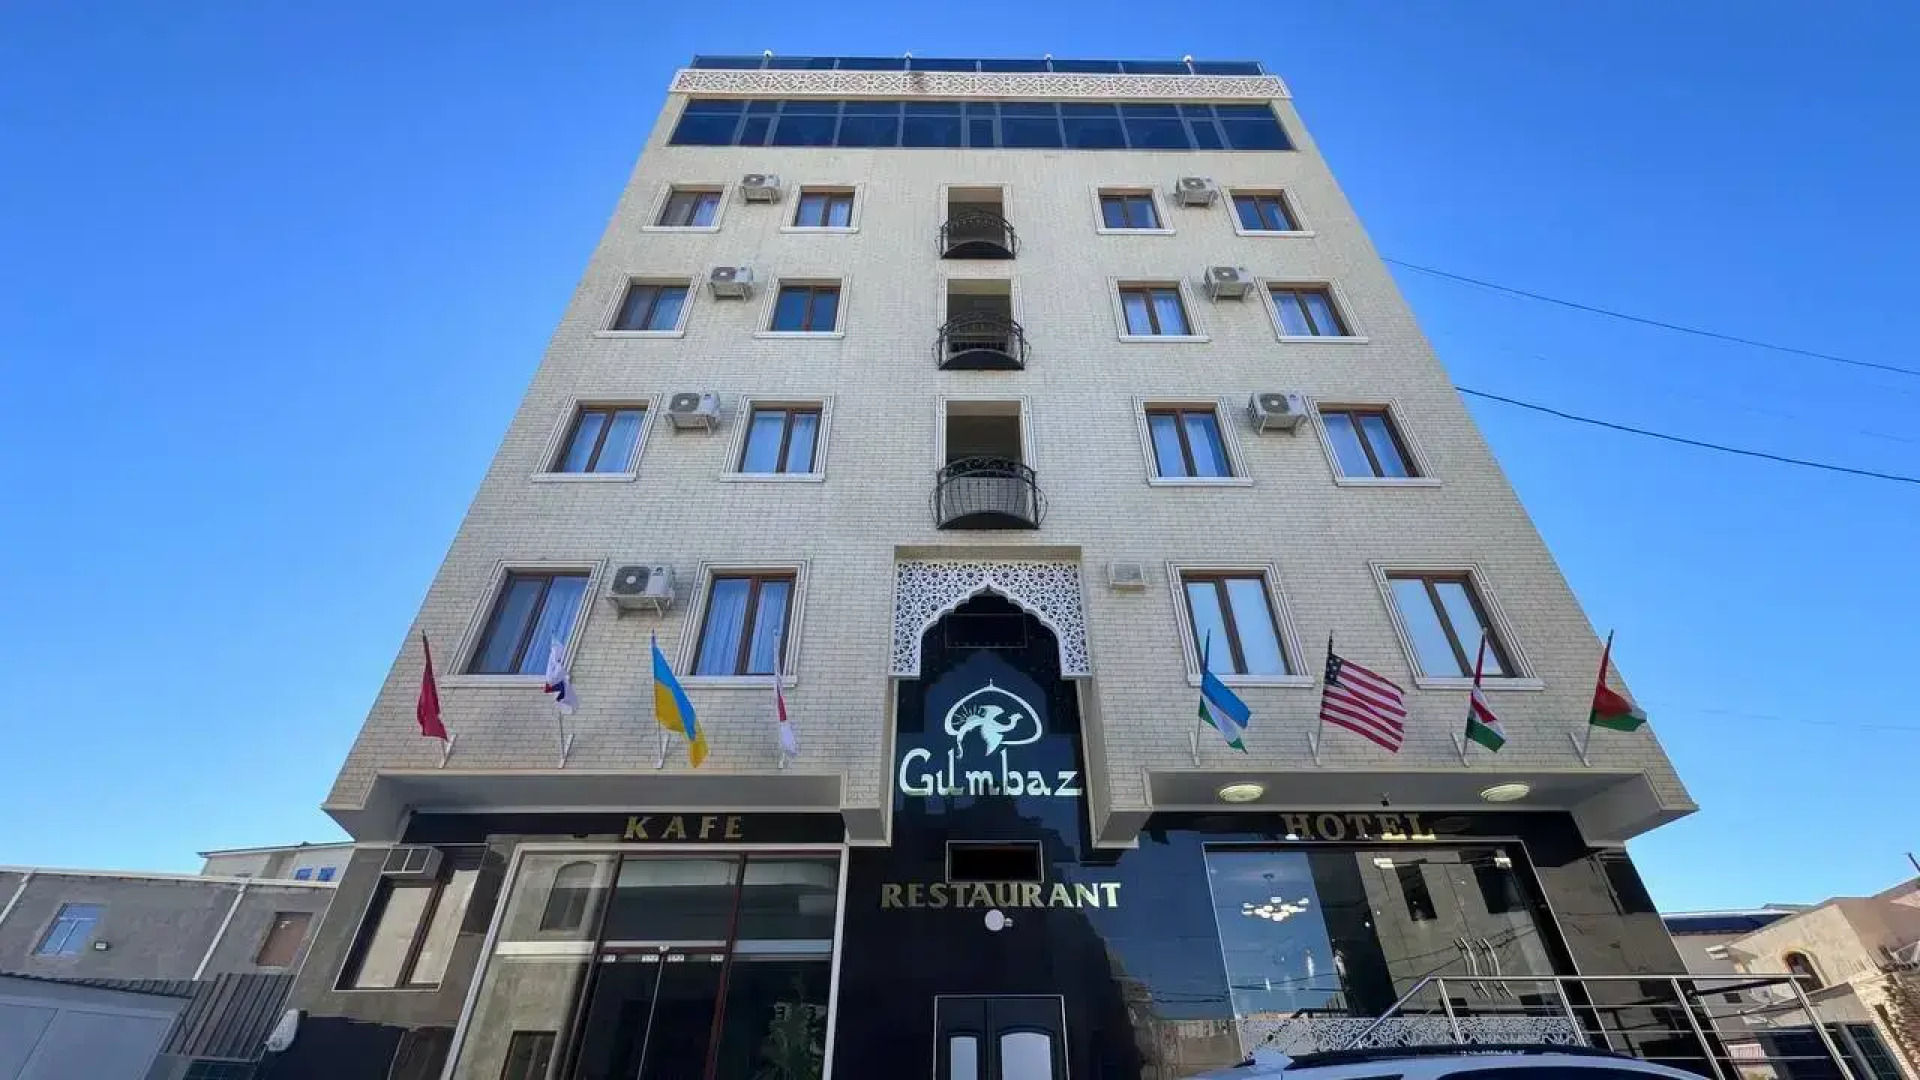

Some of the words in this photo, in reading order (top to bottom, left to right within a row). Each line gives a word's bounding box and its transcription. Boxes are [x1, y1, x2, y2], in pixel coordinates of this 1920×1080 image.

[623, 815, 744, 840] KAFE
[1280, 813, 1436, 841] HOTEL
[881, 882, 1121, 908] RESTAURANT
